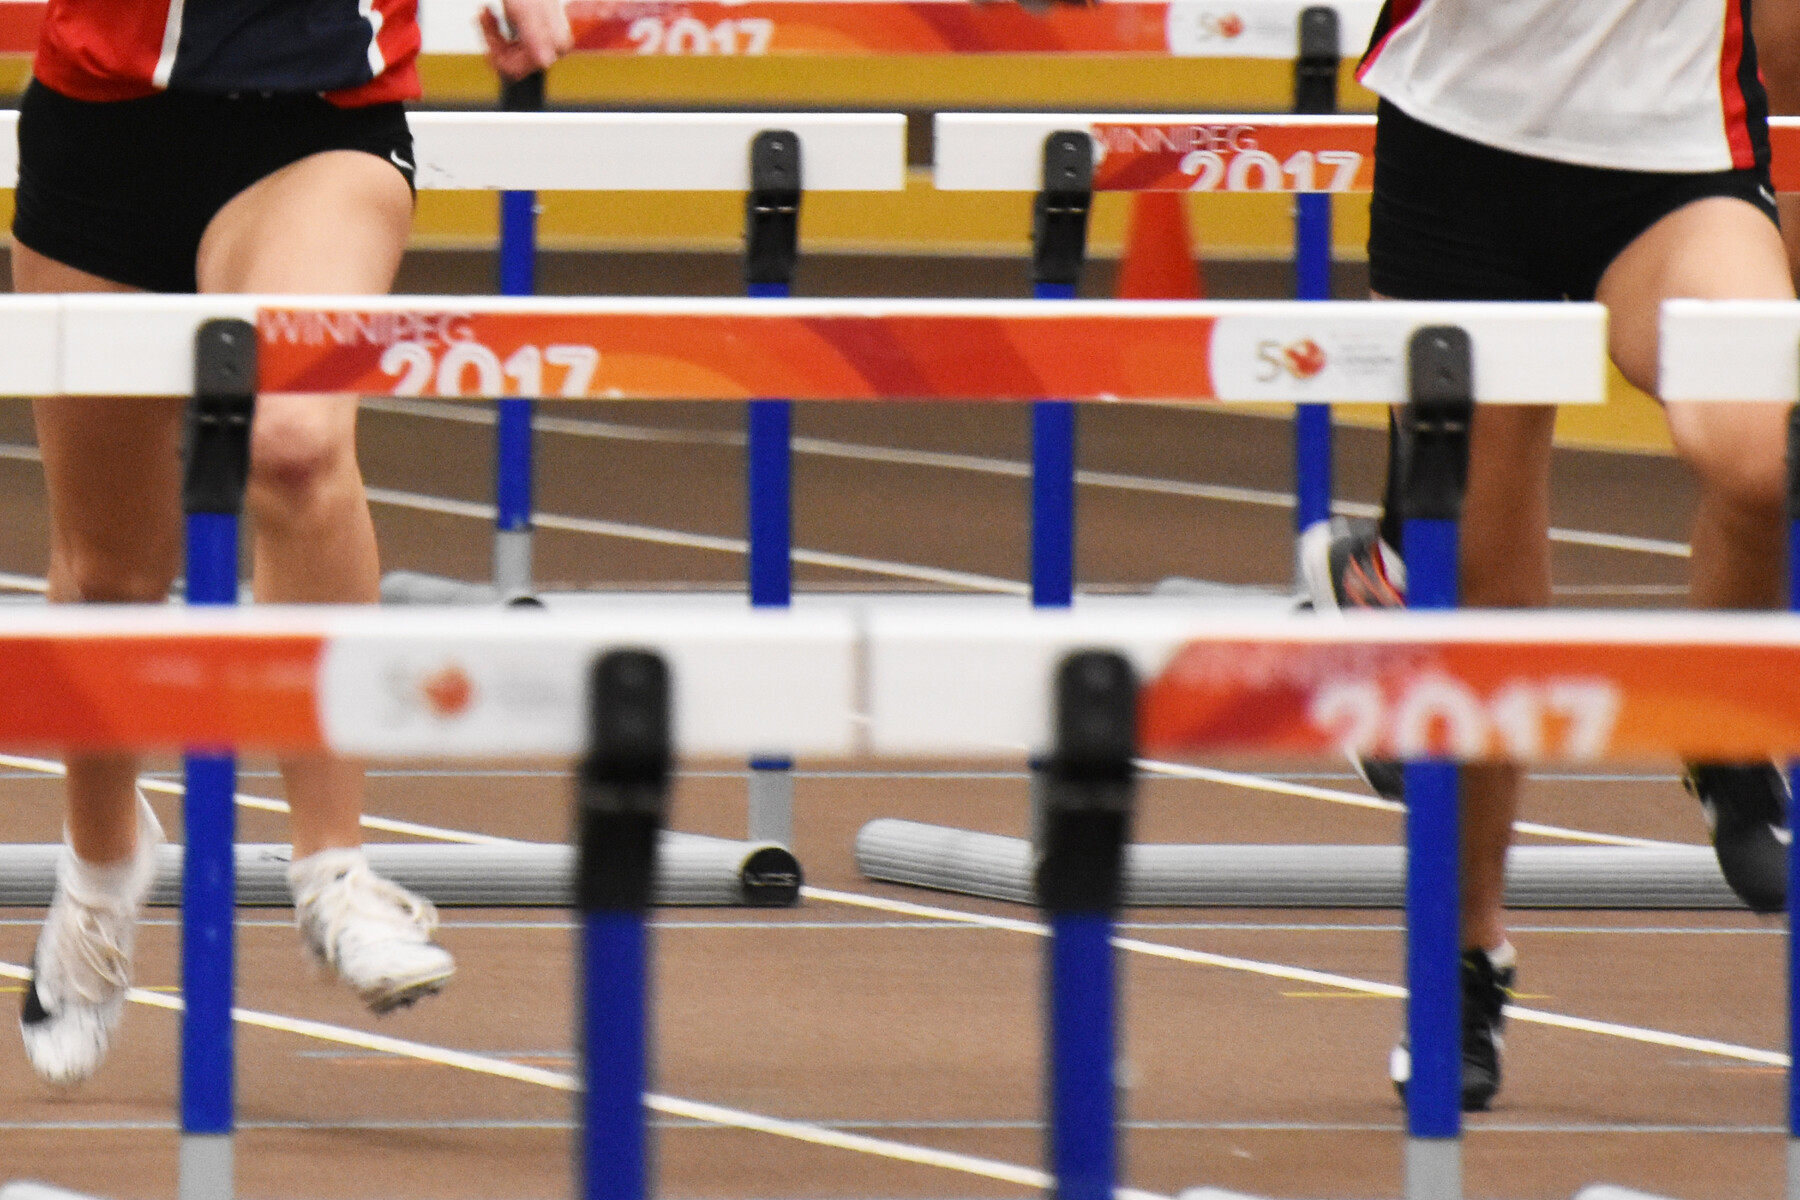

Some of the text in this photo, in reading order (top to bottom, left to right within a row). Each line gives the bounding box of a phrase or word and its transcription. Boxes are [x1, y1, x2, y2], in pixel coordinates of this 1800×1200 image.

[629, 17, 774, 56] 2017
[1179, 149, 1363, 192] 2017
[380, 340, 600, 398] 2017
[1309, 673, 1622, 760] 2017
